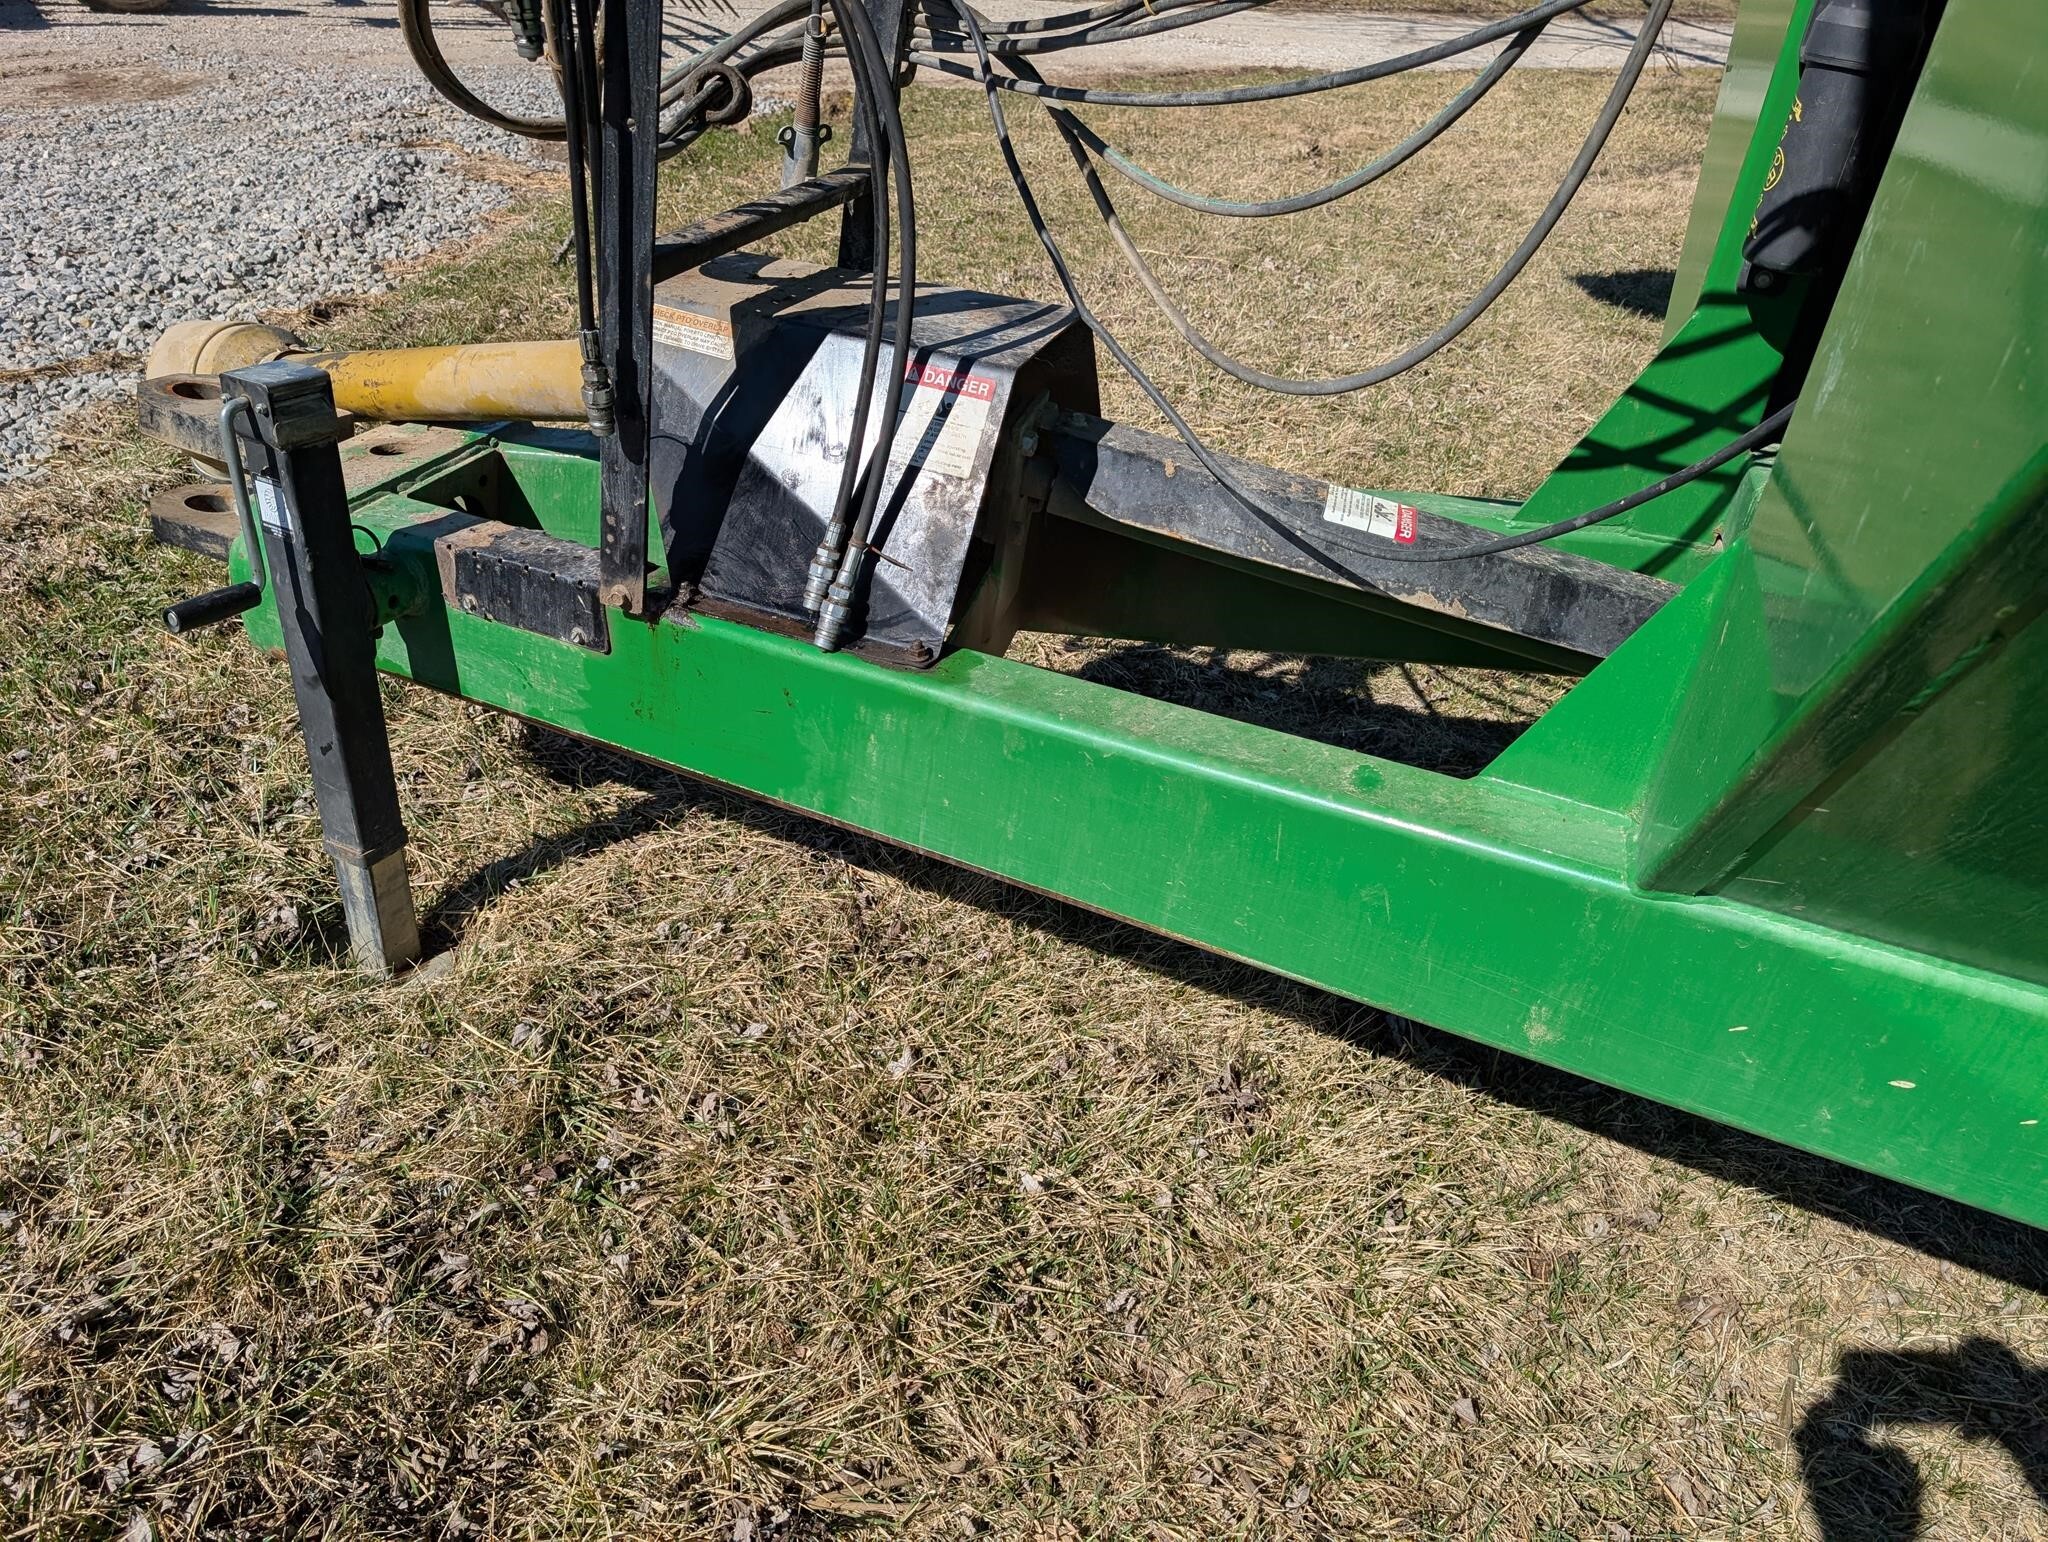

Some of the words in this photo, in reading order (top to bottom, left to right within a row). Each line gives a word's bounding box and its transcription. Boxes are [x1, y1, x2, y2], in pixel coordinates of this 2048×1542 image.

[654, 308, 675, 320] HECK
[676, 313, 691, 324] PTO
[692, 318, 728, 333] OVERLAP
[923, 370, 990, 396] DANGER
